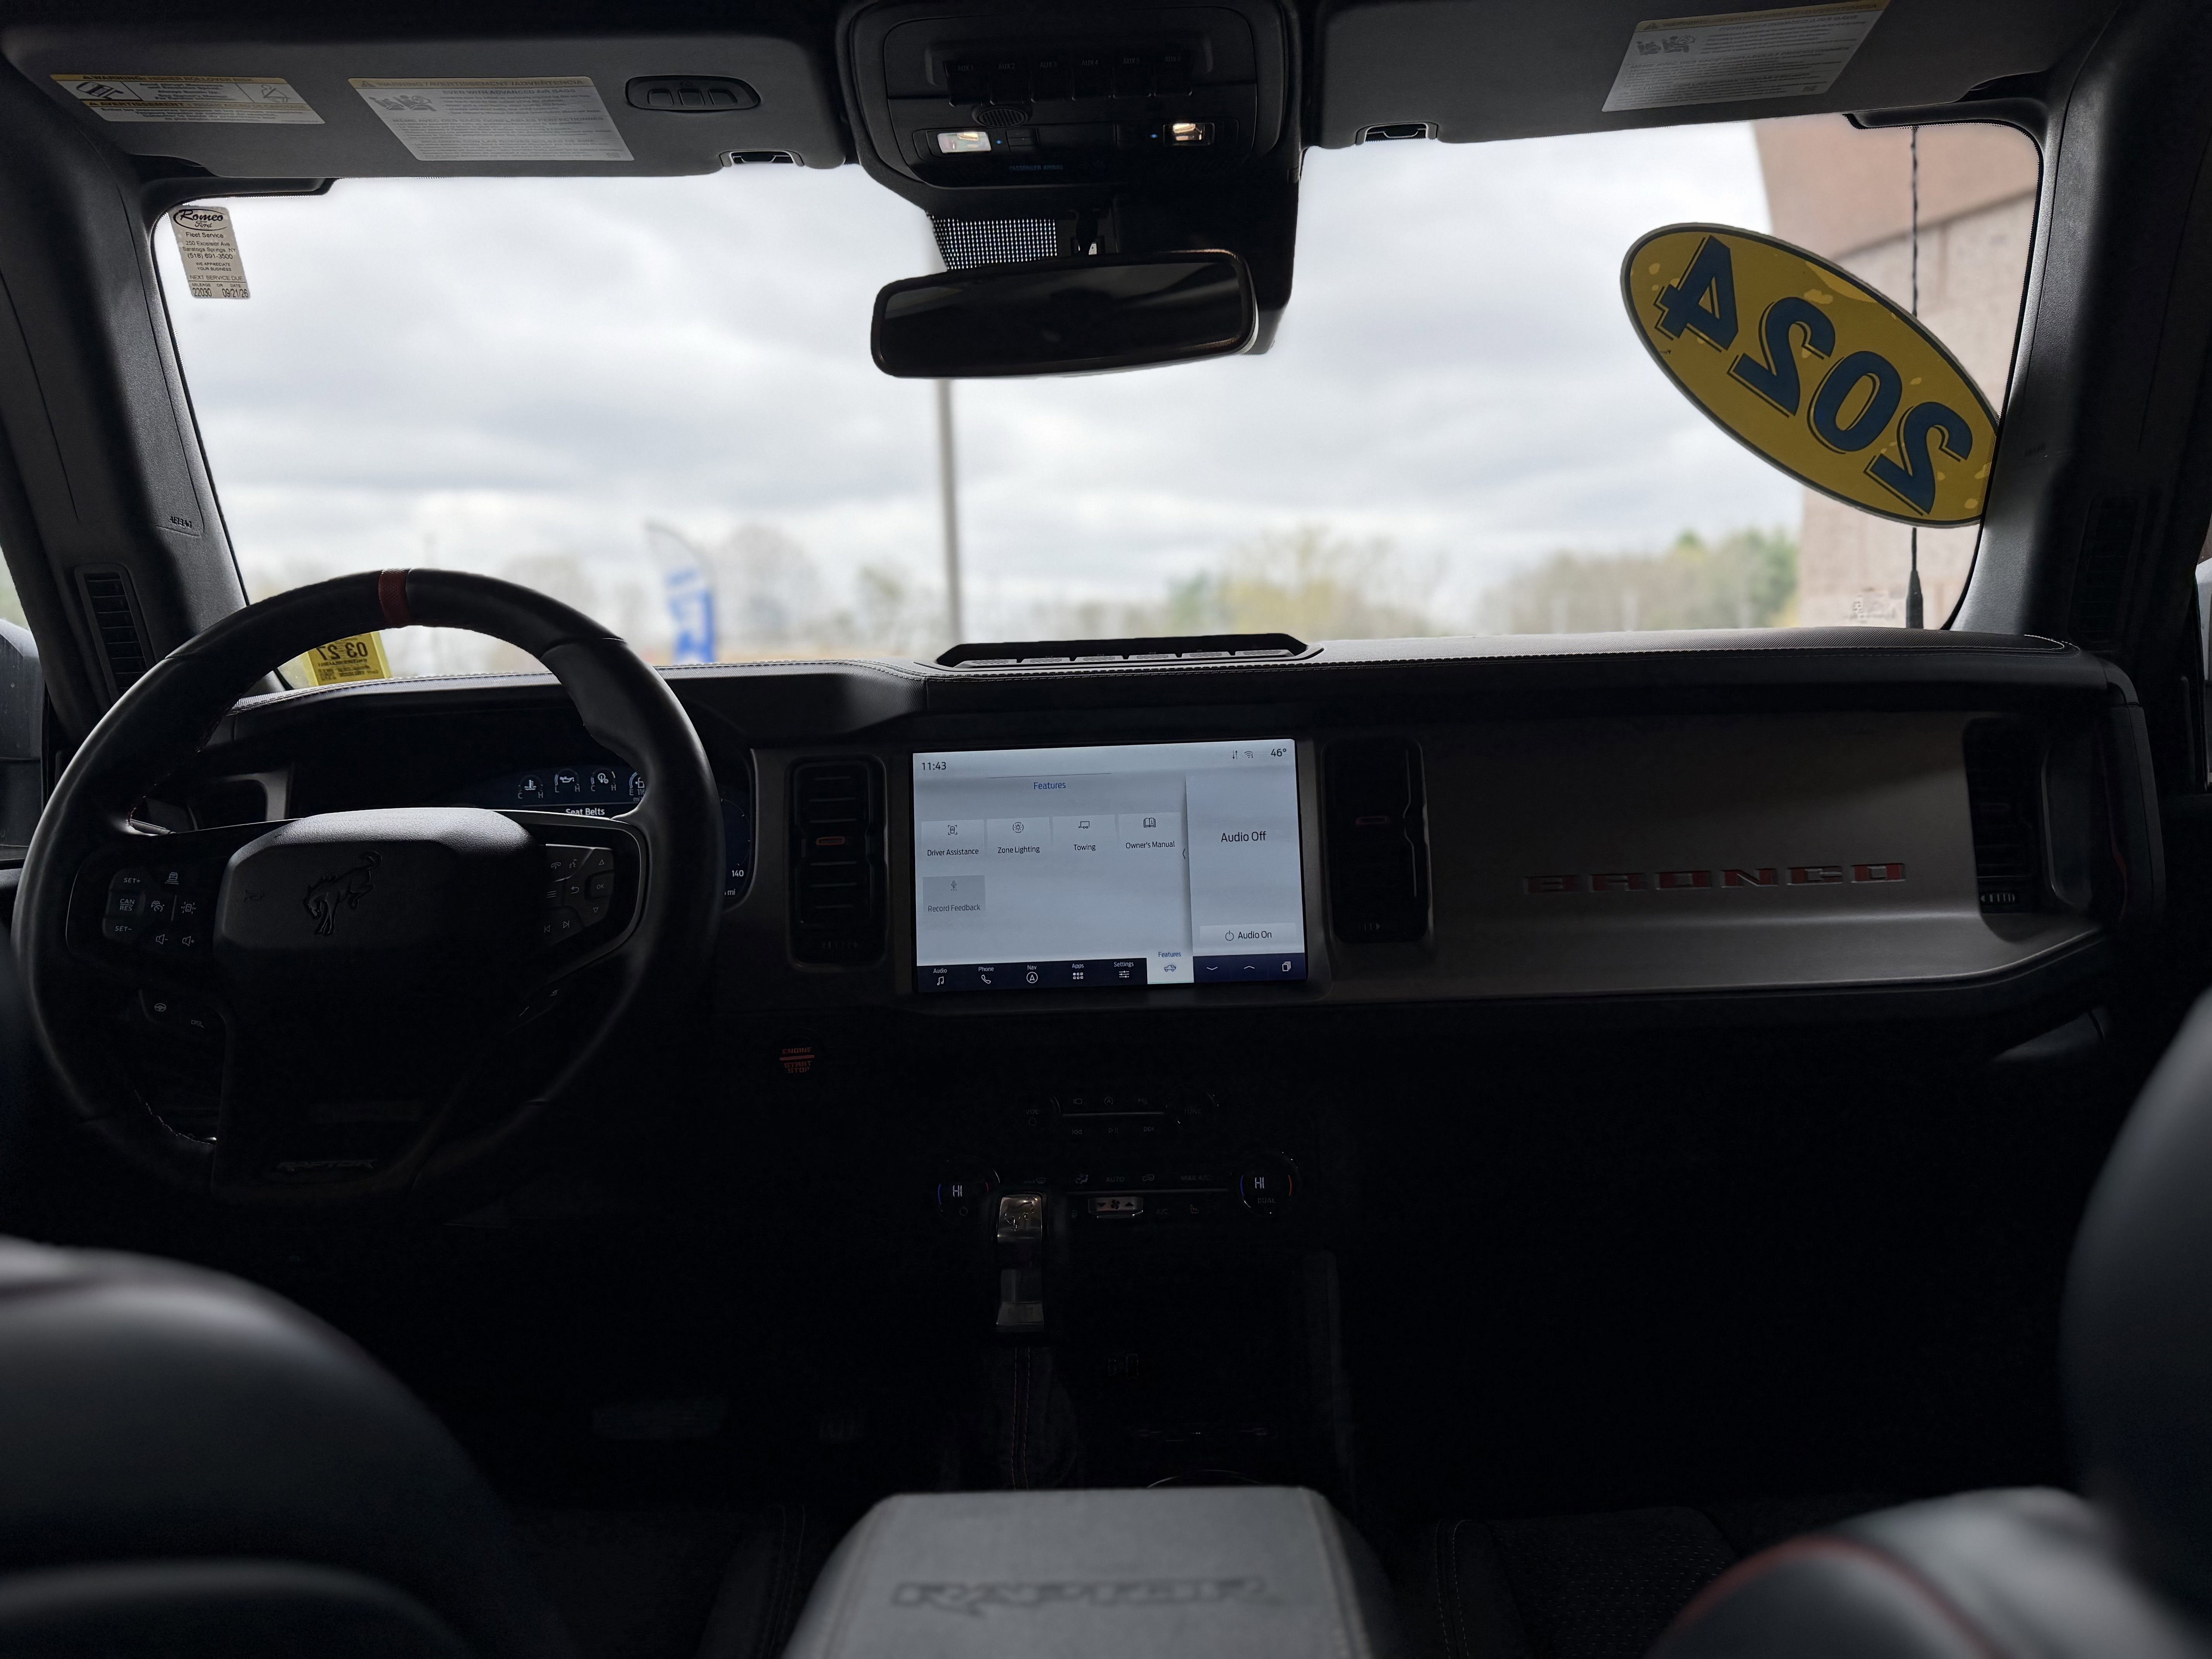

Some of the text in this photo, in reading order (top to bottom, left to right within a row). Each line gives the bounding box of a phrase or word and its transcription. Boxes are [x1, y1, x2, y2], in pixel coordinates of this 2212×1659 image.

[179, 210, 223, 221] Romeo
[192, 288, 212, 297] 22030
[222, 288, 249, 298] 09/21/26
[1271, 748, 1287, 757] 46°
[921, 762, 947, 771] 11:43
[1034, 781, 1066, 790] Features
[1221, 831, 1267, 843] Audio Off
[1524, 864, 1905, 893] BRONCO
[1238, 931, 1272, 939] Audio On
[1254, 1176, 1265, 1190] HI
[952, 1184, 963, 1197] HI
